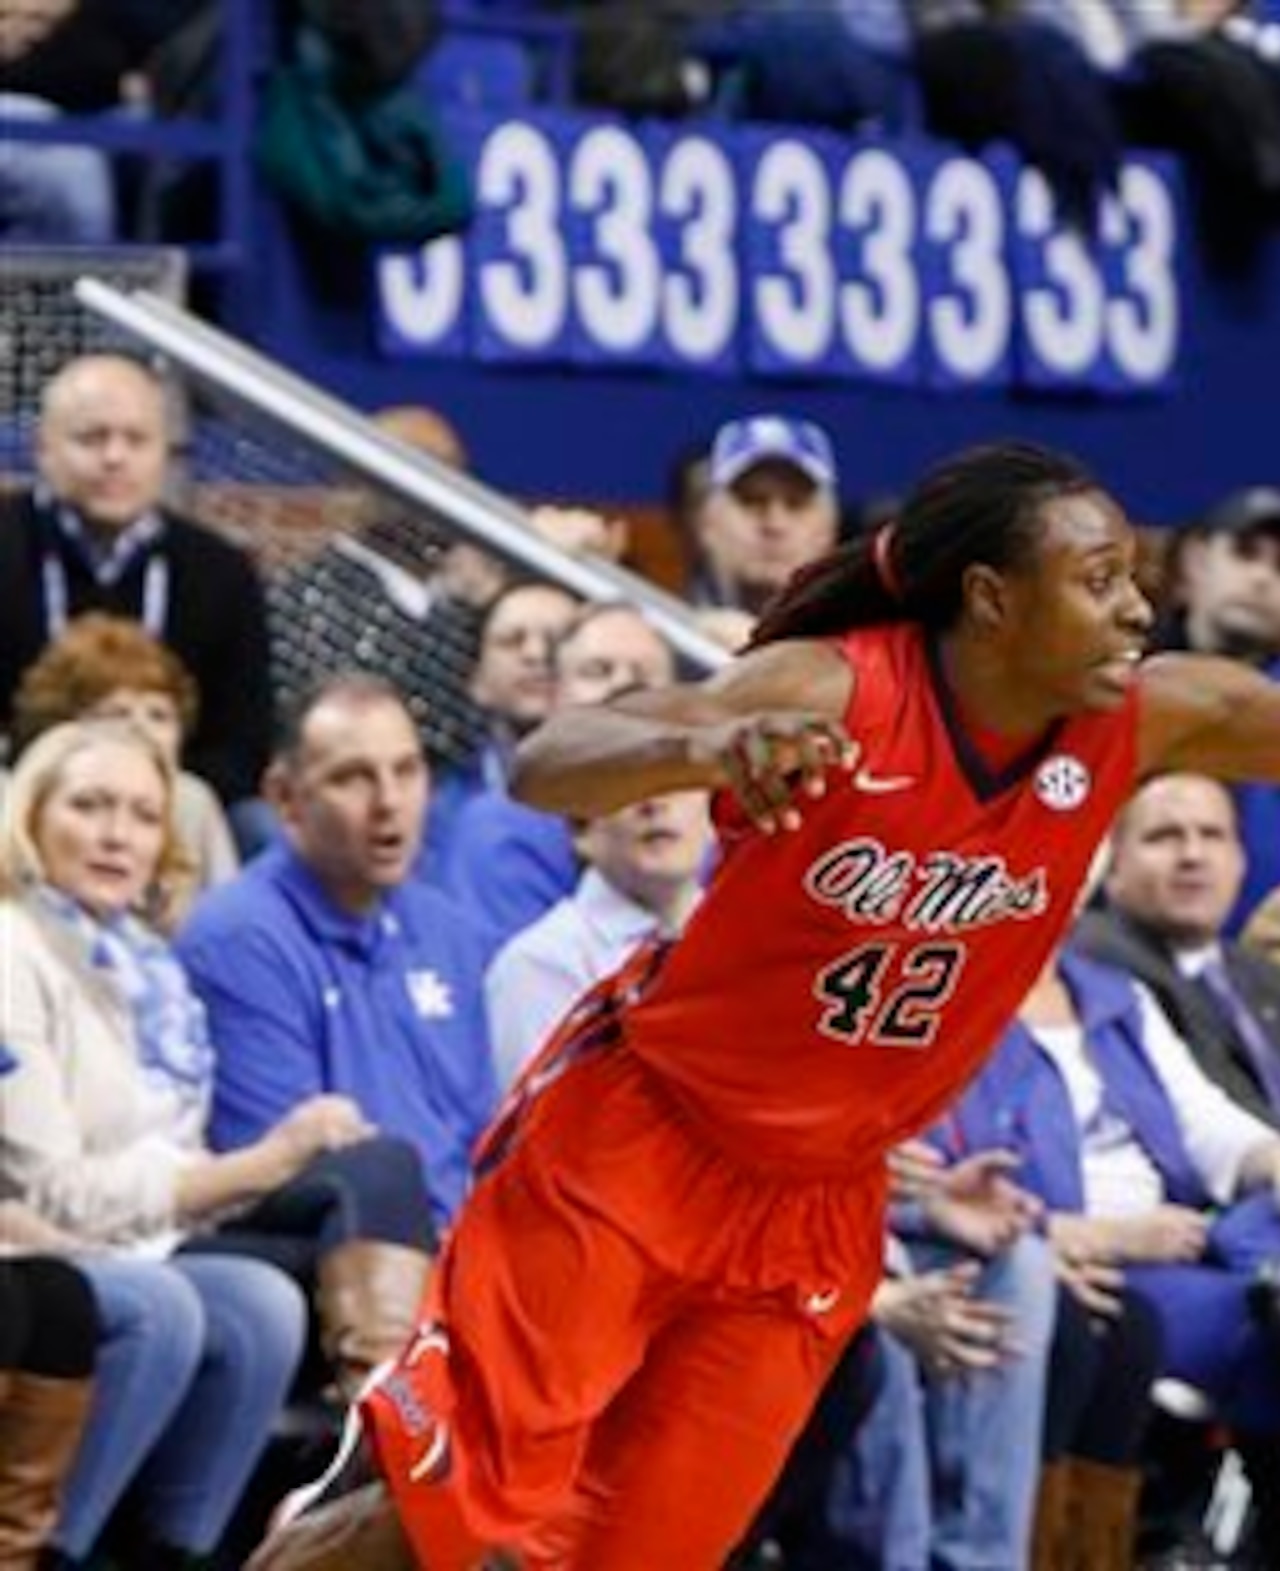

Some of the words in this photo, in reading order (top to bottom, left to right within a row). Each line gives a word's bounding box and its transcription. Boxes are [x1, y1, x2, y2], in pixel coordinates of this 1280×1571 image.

[803, 837, 914, 926] Ole
[902, 851, 1048, 935] Miss
[813, 940, 966, 1048] 42
